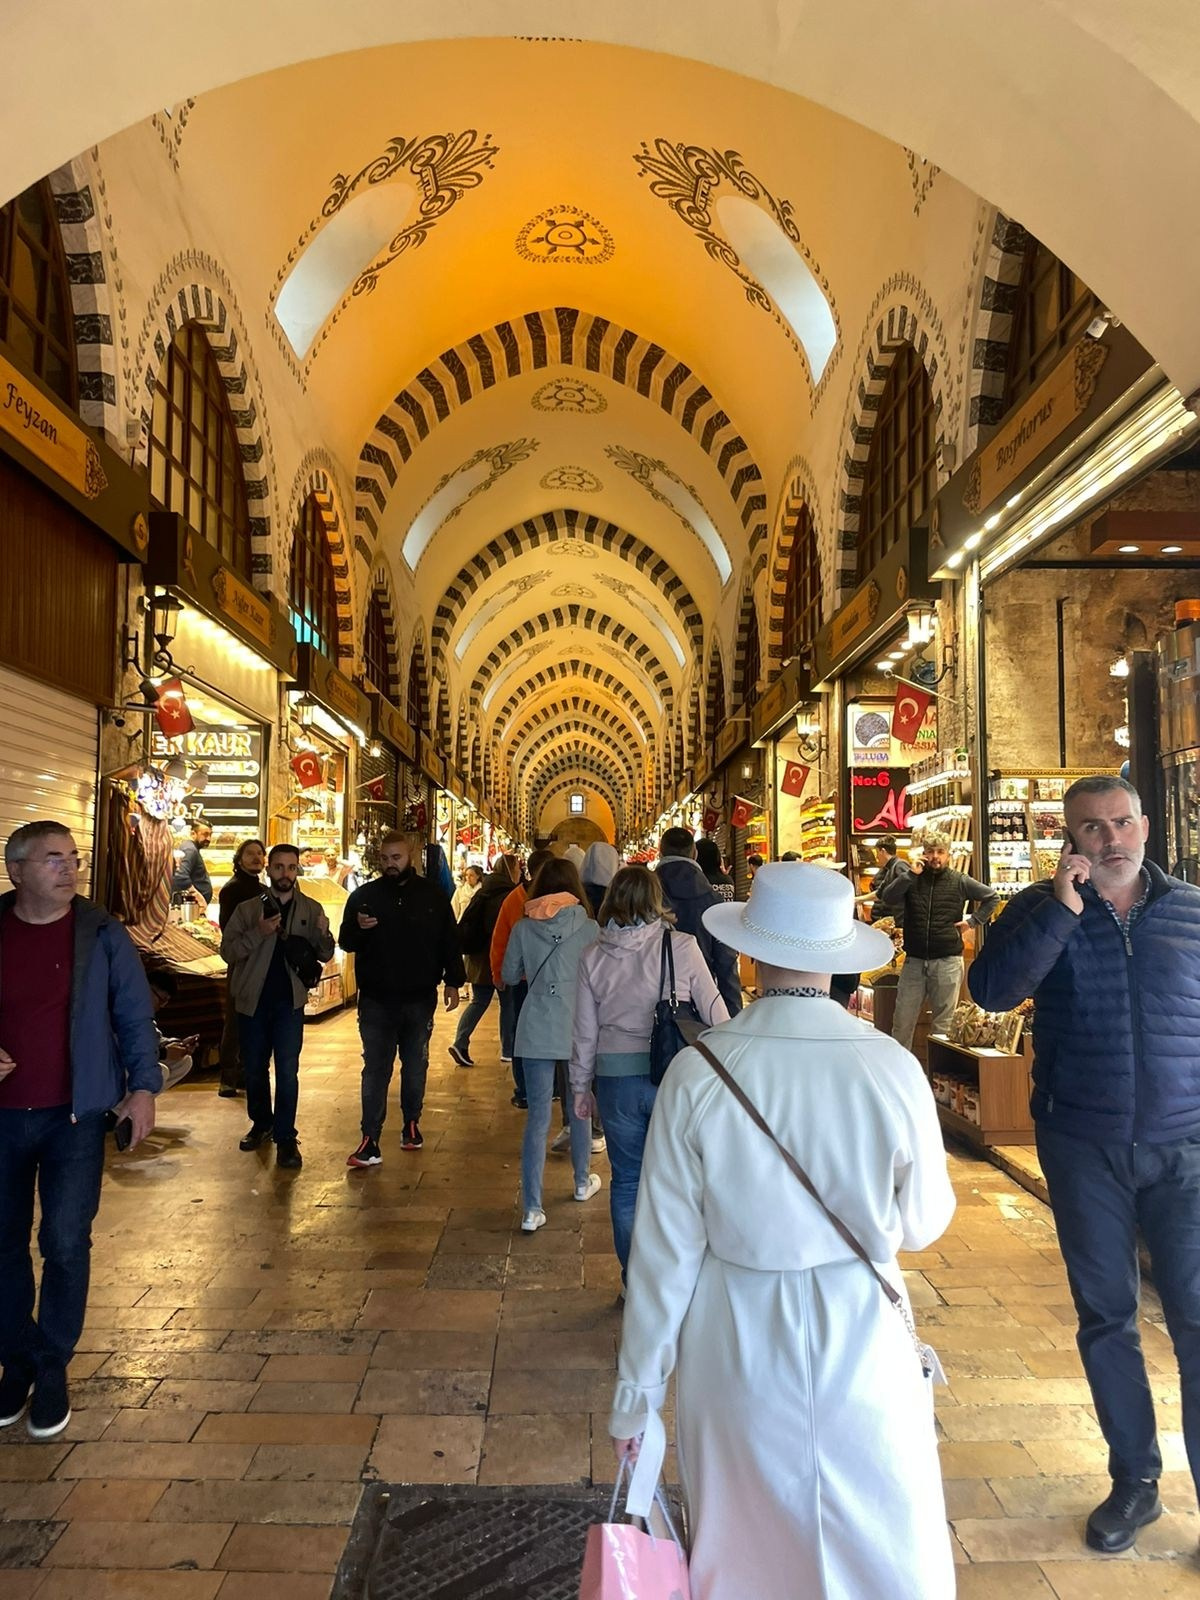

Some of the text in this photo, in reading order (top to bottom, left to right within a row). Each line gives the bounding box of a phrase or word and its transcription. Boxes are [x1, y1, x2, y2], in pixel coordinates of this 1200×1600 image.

[3, 383, 57, 445] Feyzan
[996, 397, 1055, 472] Bosphorus
[187, 732, 252, 756] KAUR
[853, 771, 890, 787] No:6
